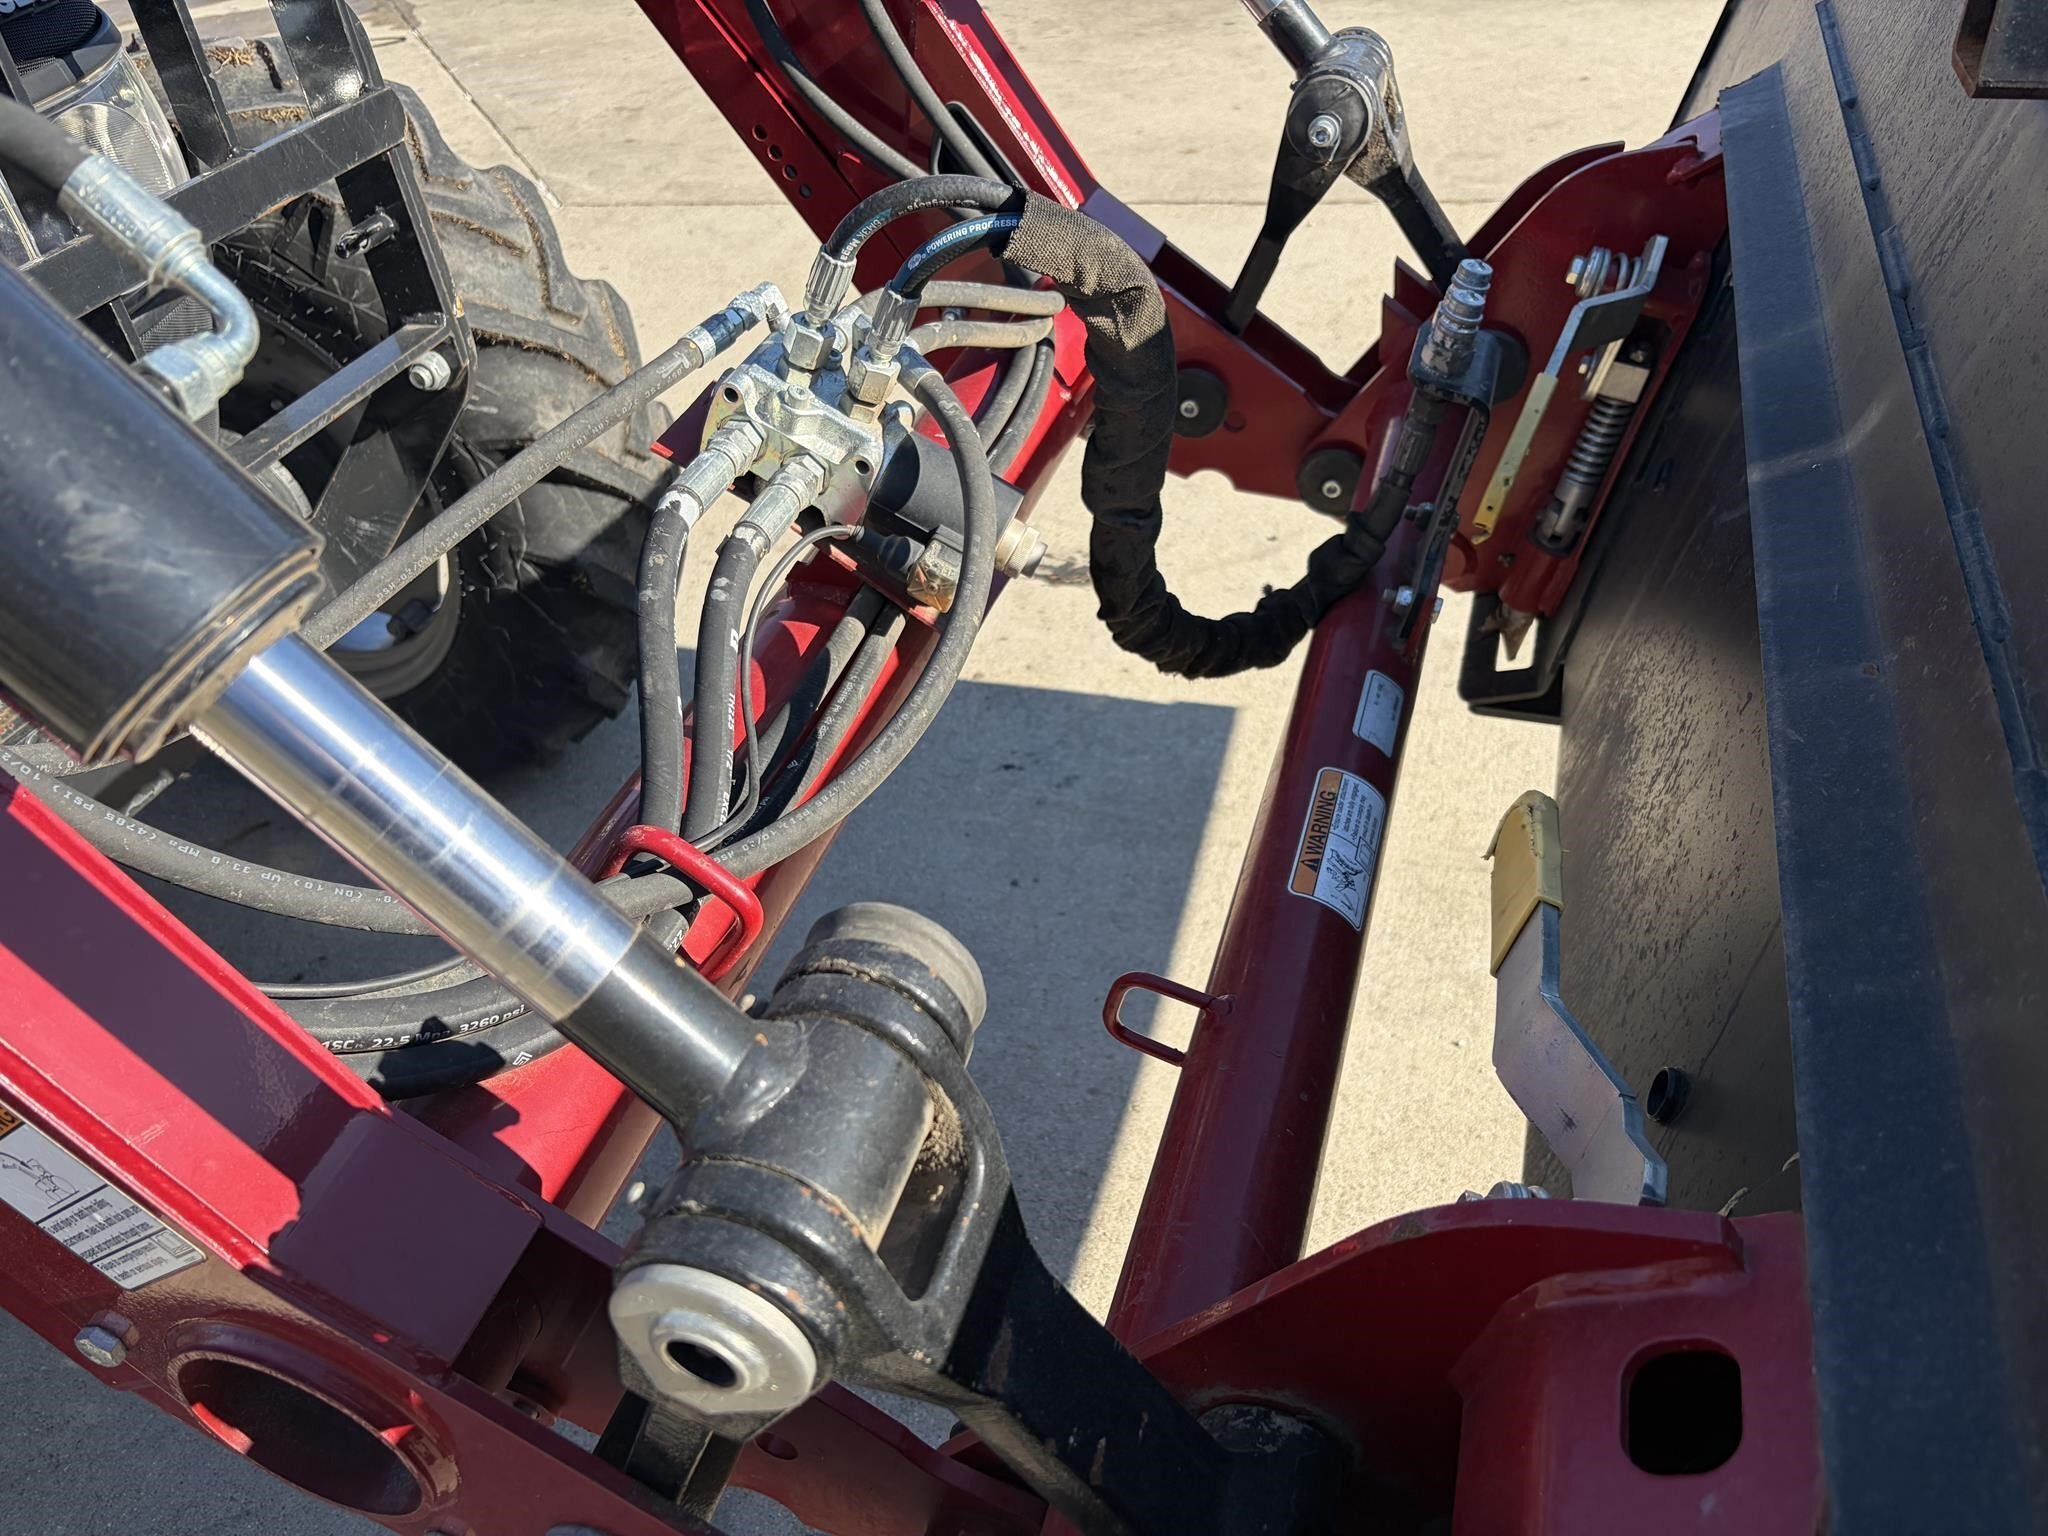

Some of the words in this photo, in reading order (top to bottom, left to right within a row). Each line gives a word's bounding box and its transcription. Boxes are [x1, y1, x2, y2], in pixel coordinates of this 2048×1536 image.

[926, 227, 968, 254] POWERING
[969, 219, 1018, 233] PROGRESS
[725, 691, 737, 731] TH225
[0, 752, 41, 781] 10/2
[50, 781, 95, 813] PSI)
[1306, 790, 1336, 857] WARNING
[166, 838, 201, 858] MPa
[209, 853, 252, 874] 33.0
[259, 870, 281, 883] WP
[370, 1035, 411, 1049] 22.5
[459, 1015, 500, 1033] 3260
[501, 1004, 526, 1022] psi
